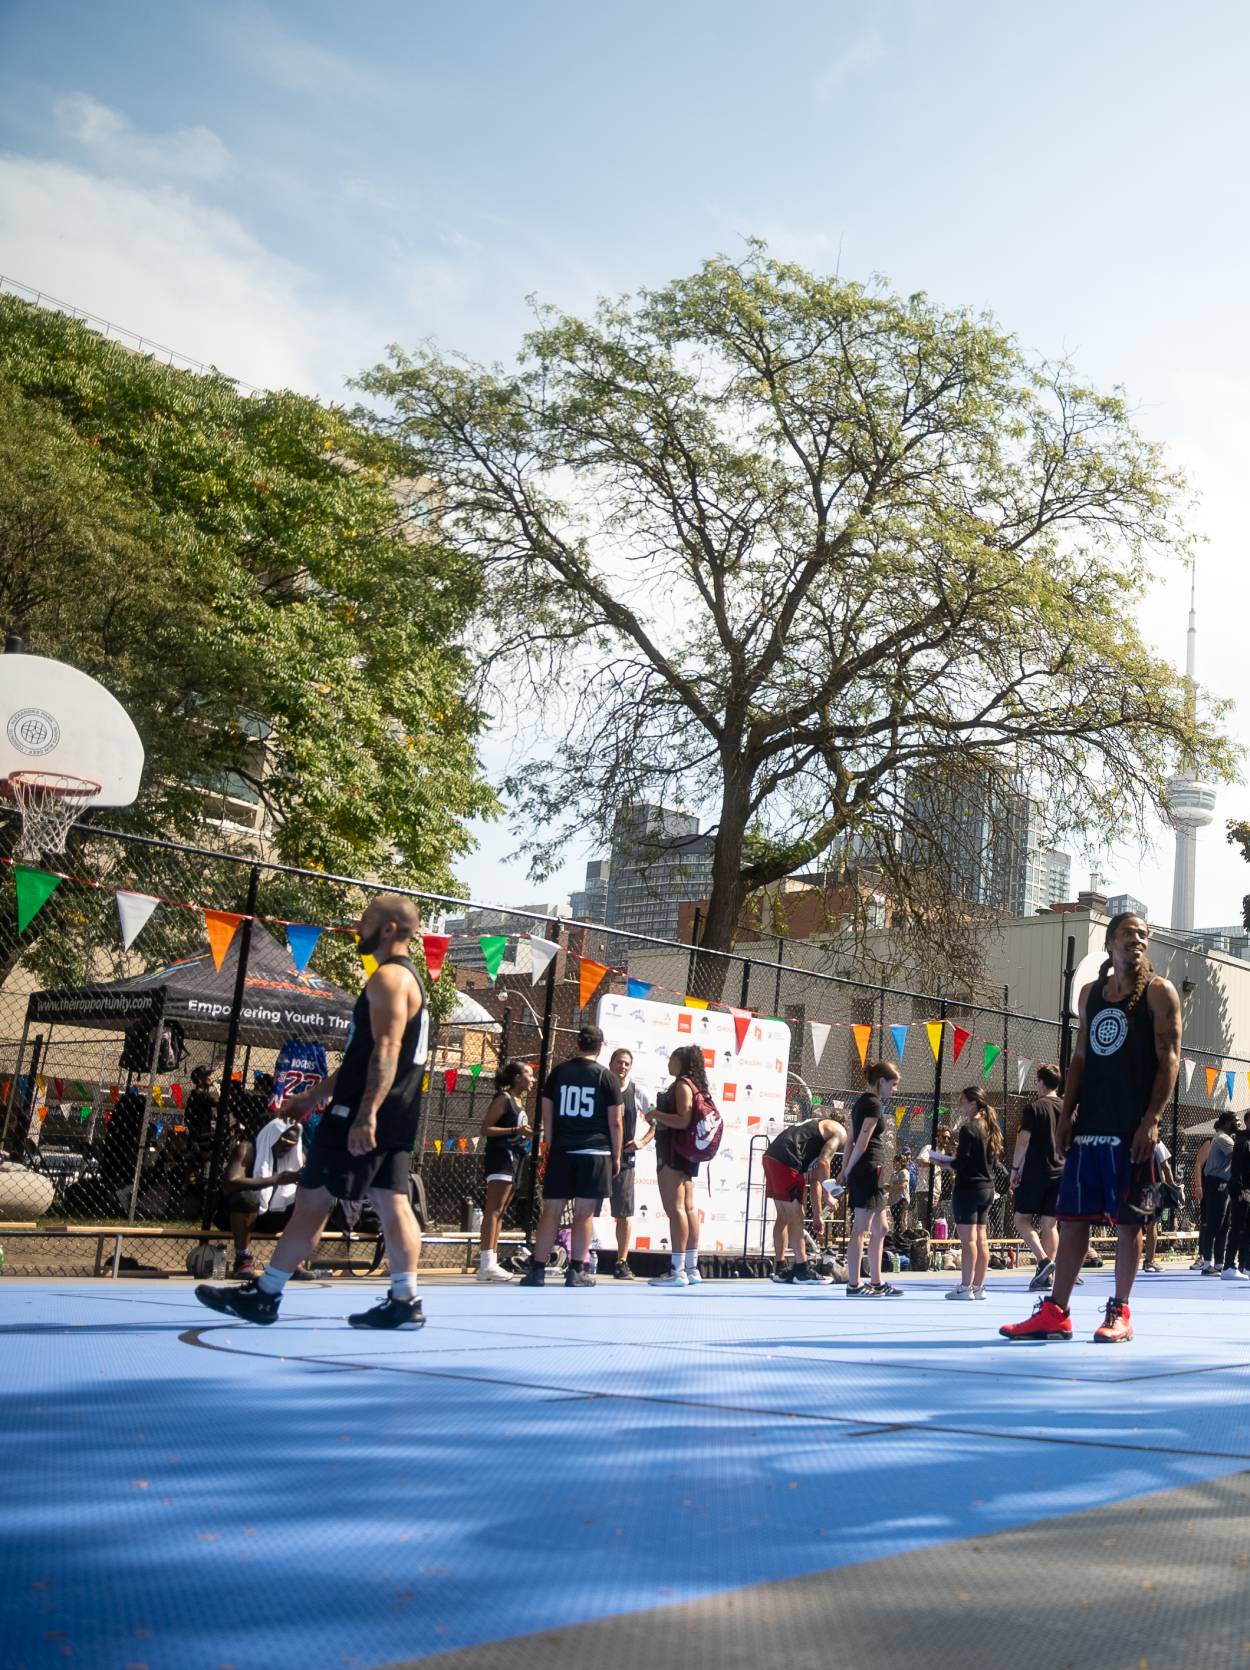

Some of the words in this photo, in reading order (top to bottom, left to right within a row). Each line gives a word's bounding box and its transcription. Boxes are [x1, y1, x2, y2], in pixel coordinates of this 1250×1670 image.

[37, 995, 152, 1015] www.theiropportunity.com
[188, 1000, 281, 1023] Empoering
[284, 1010, 324, 1027] Youth
[560, 1085, 595, 1118] 105
